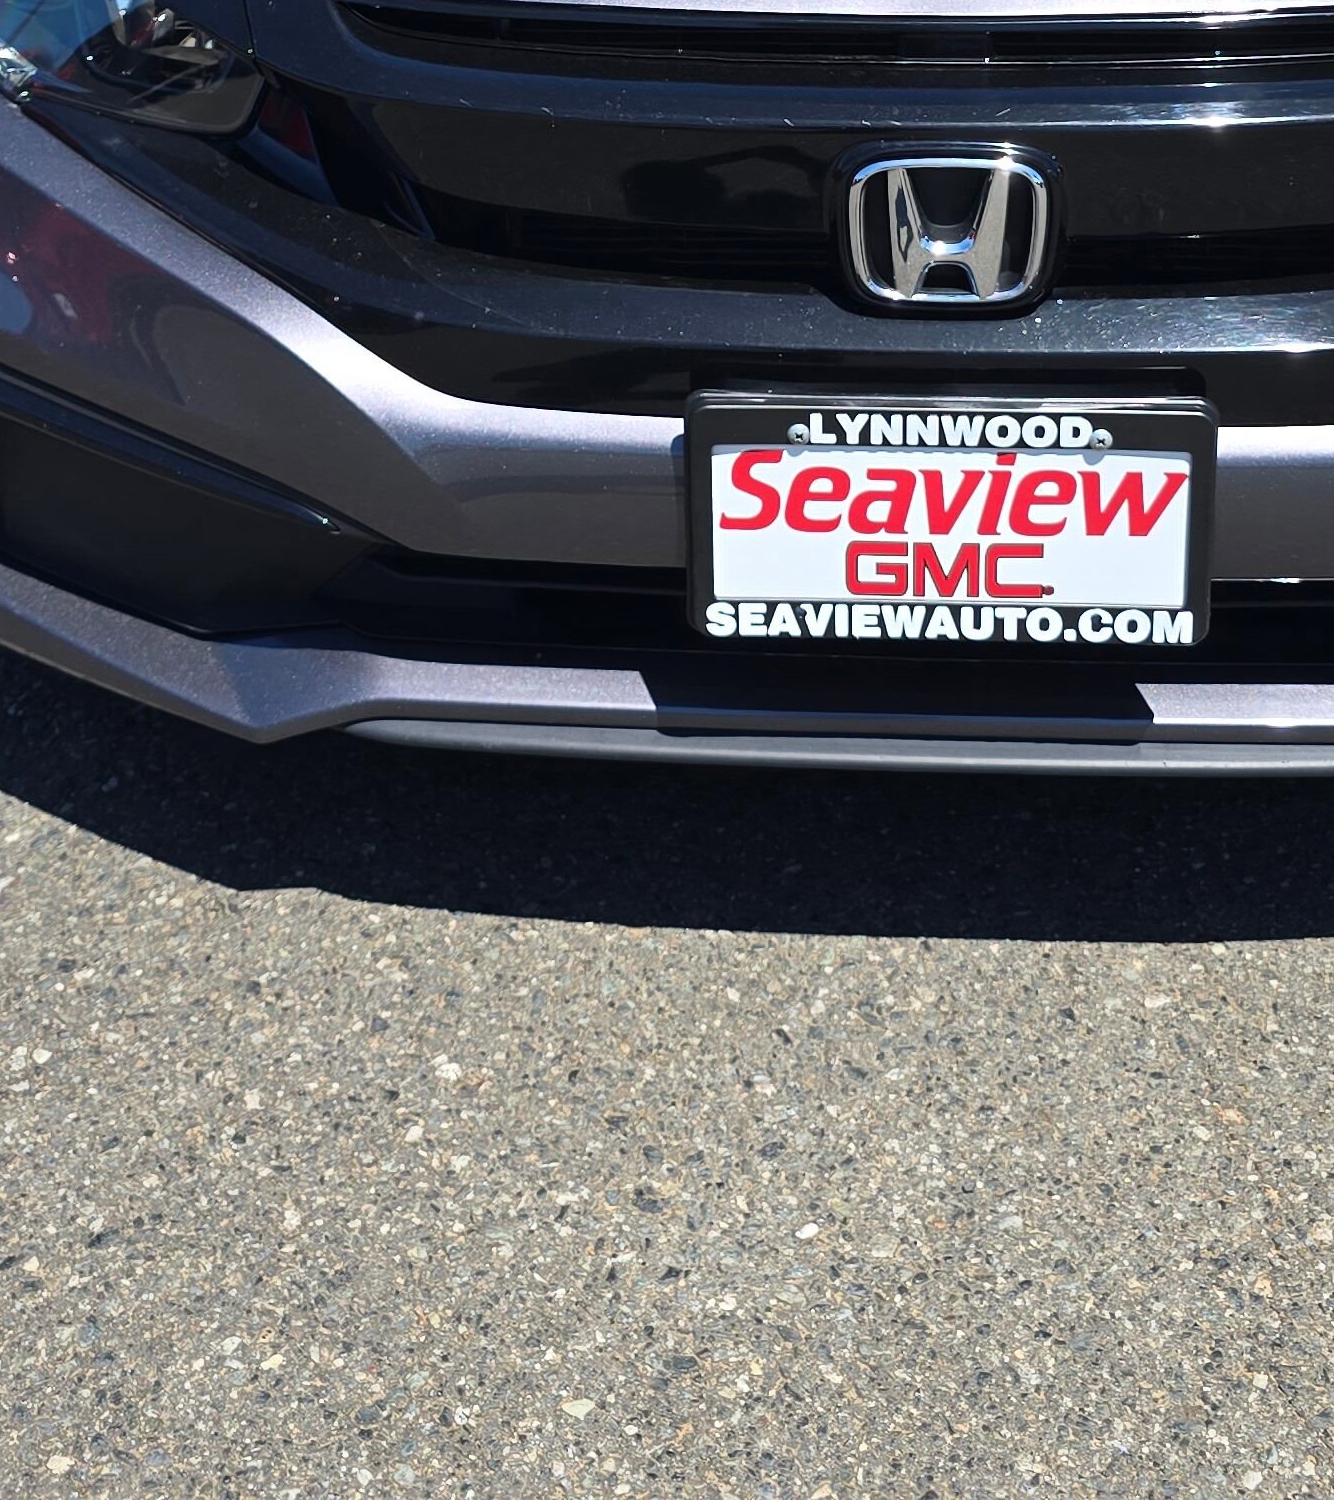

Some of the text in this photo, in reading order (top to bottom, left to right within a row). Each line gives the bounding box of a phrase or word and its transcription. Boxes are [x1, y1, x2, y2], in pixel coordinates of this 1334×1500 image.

[808, 411, 1094, 450] LYNNWOOD
[719, 449, 1189, 537] Seaview
[845, 540, 1055, 599] GMC
[704, 601, 1195, 645] SEAVIEWAUTO.COM
